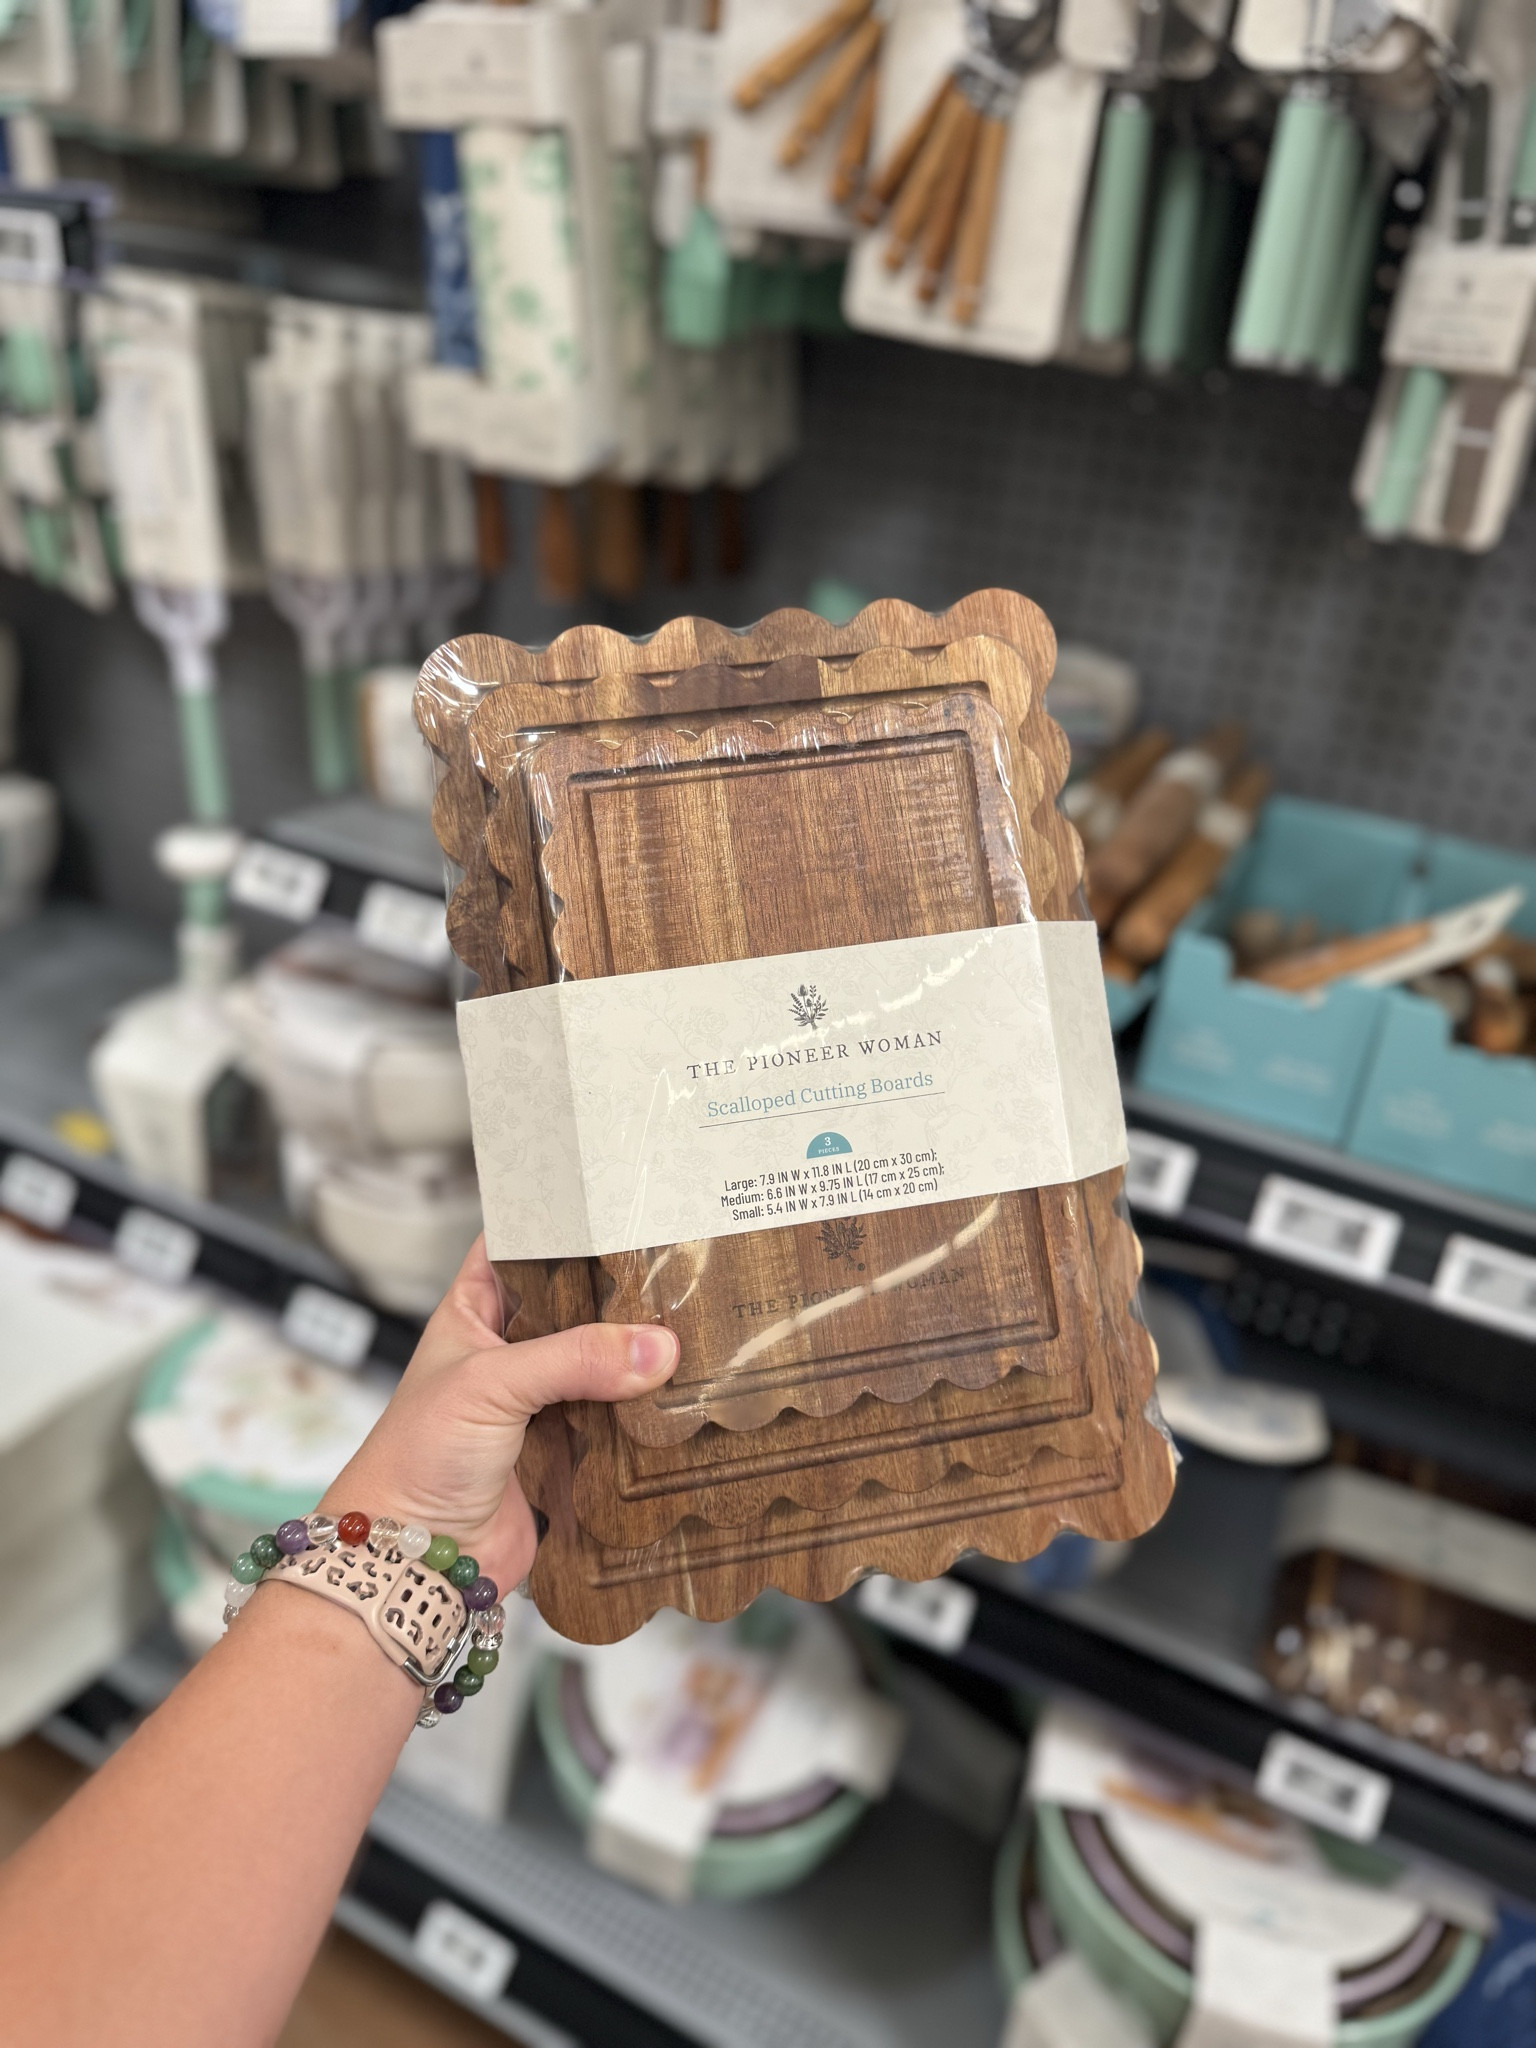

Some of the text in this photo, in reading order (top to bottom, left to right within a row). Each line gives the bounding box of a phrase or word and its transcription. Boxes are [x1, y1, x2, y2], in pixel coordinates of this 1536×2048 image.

[686, 1030, 942, 1079] THE PIONEER WOMAN
[707, 1071, 934, 1117] Scalloped Cutting Boards
[818, 1146, 840, 1155] PIECES
[824, 1136, 832, 1146] 3
[720, 1162, 945, 1208] Medium: 6.6 IN W x 9.75 IN L (17 cm x 25 cm);
[725, 1148, 938, 1192] Large: 7.9 IN W x 11.8 IN L (20 cm x 30 cm);
[732, 1178, 938, 1221] Small: 5.4 IN W x 7.9 IN L (14 cm x 20 cm)
[732, 1299, 778, 1319] THE
